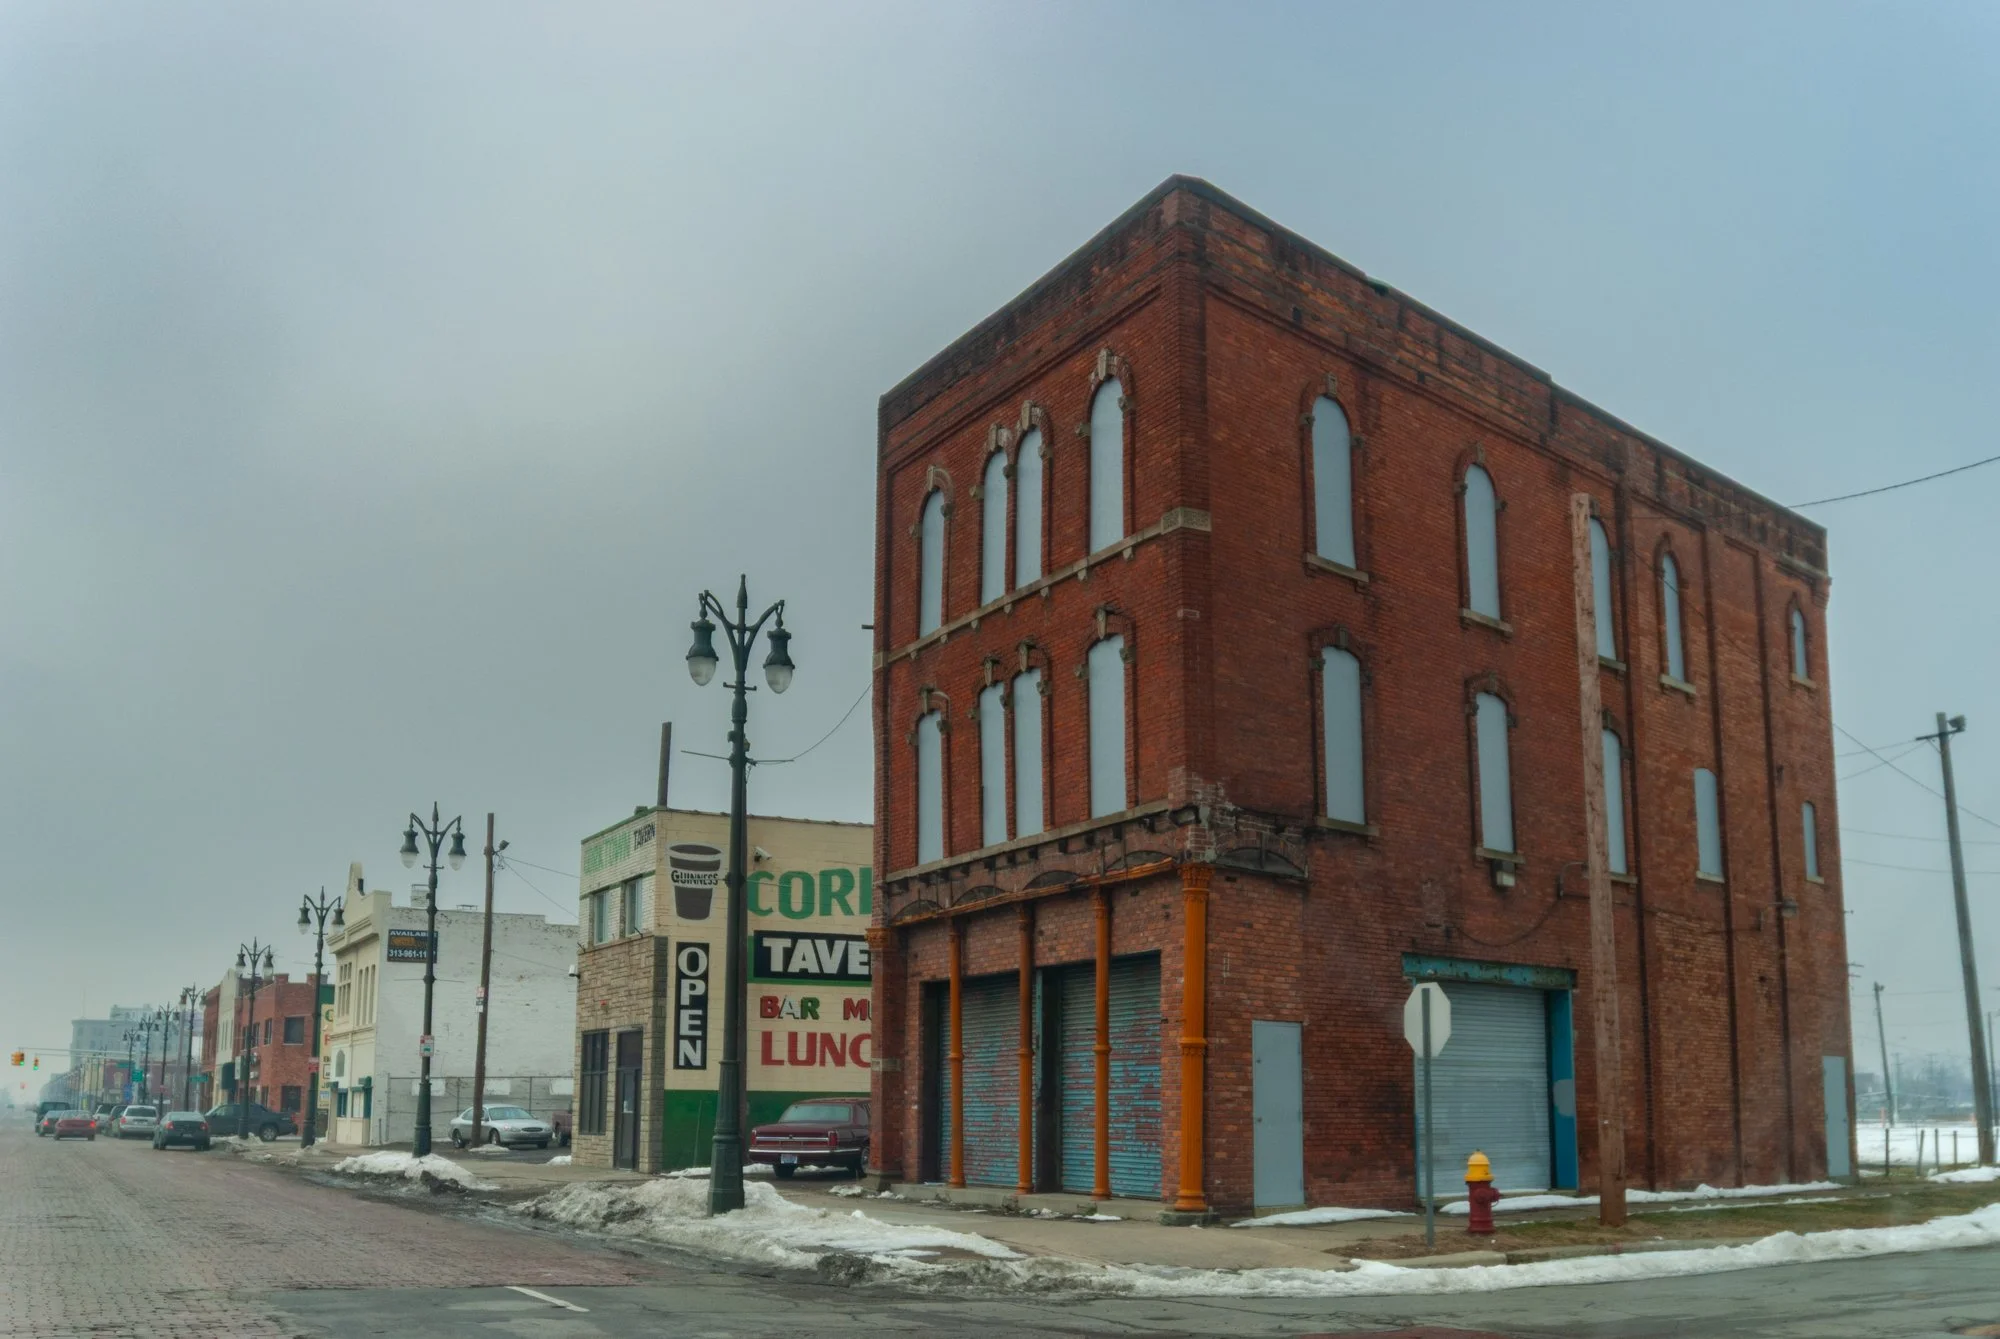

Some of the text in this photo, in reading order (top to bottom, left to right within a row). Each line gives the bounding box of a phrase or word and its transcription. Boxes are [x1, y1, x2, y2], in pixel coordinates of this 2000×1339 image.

[633, 821, 656, 850] TAVERN
[676, 947, 708, 1067] OPEN
[760, 995, 820, 1020] BAR
